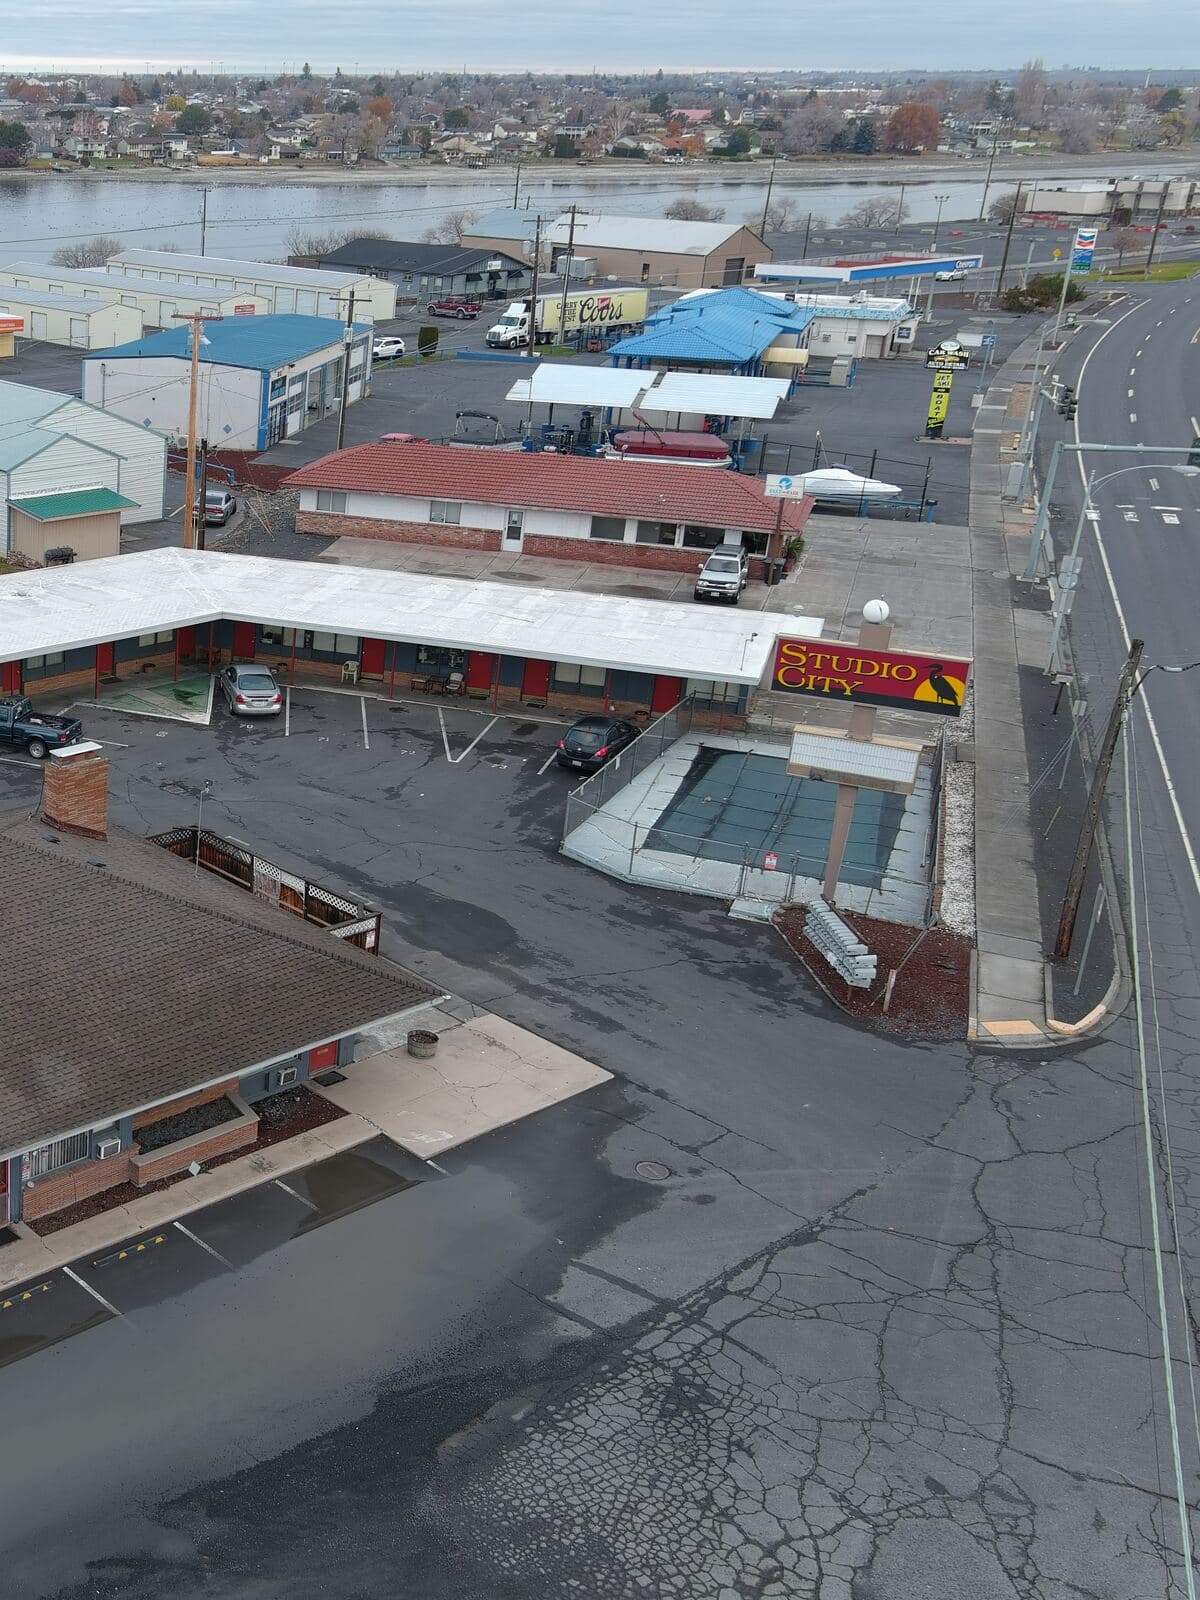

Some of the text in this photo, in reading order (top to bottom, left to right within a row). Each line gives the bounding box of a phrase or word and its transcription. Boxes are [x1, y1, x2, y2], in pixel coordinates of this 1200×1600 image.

[580, 297, 623, 323] Coors
[946, 350, 969, 358] WASH
[780, 643, 918, 682] STUDIO
[777, 665, 864, 696] CITY
